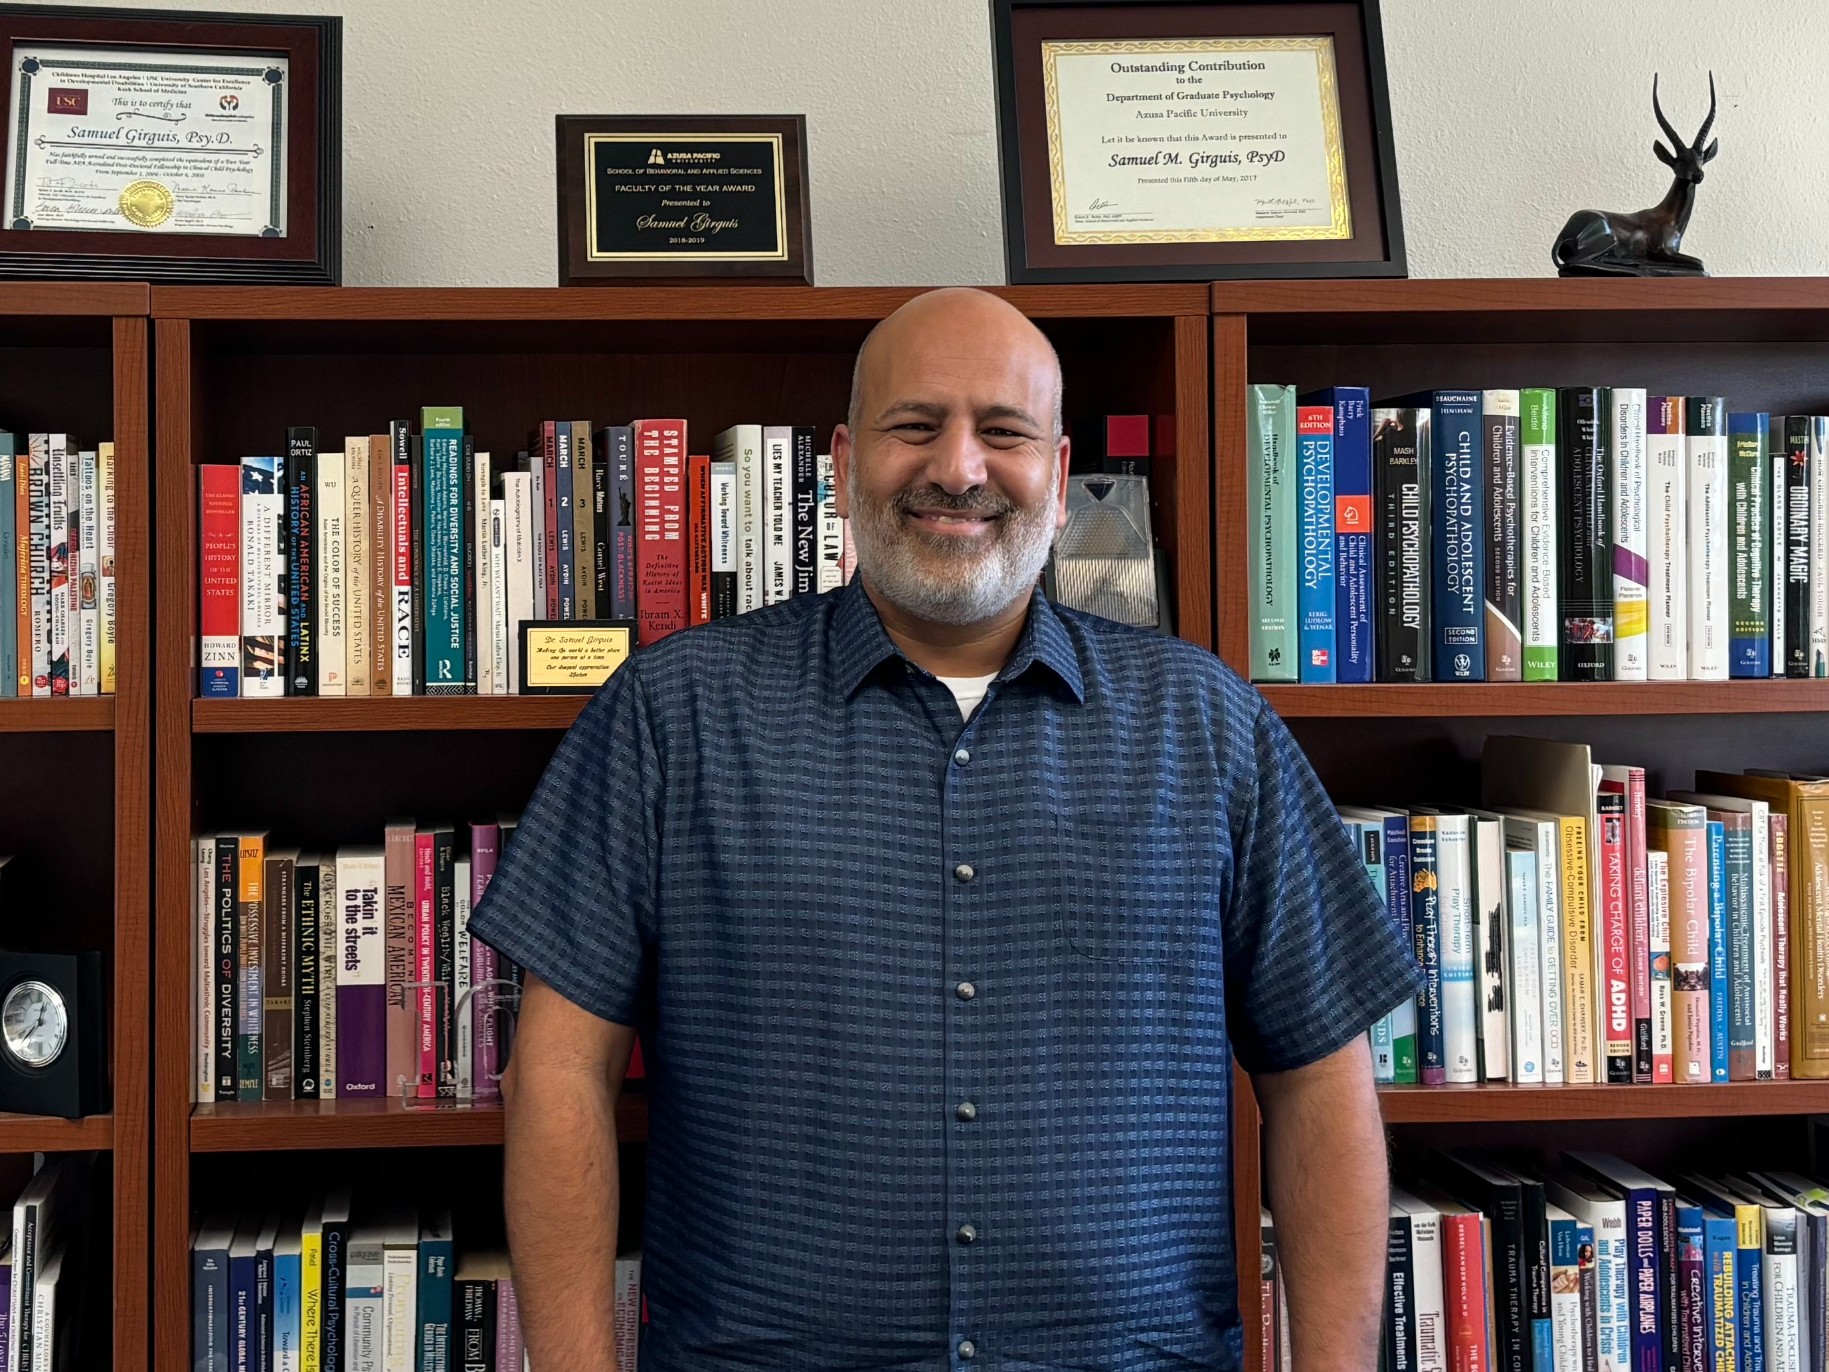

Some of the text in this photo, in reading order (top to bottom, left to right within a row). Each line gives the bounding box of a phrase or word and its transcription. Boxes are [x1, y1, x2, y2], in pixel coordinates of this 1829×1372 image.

[1111, 60, 1266, 74] Outstanding Contribution
[112, 98, 128, 106] This
[150, 100, 174, 110] certify
[176, 101, 192, 109] that
[1106, 90, 1275, 103] Department of Graduate Psychology
[1136, 108, 1248, 118] Azusa Pacific University
[67, 126, 232, 147] Samuel Girguis, Psy.D.
[1108, 150, 1285, 168] Samuel M. Girguis, PsyD
[1201, 133, 1228, 141] Award
[1239, 133, 1277, 142] presented
[636, 212, 738, 234] Samuel Girguis
[398, 428, 407, 459] Sowell
[449, 440, 457, 485] READINGS
[559, 435, 568, 468] MARCH
[300, 471, 306, 480] AN
[449, 488, 457, 504] FOR
[644, 430, 660, 540] THE BEGINNING
[773, 444, 783, 546] LIES MY TEACHER TOLD ME
[1492, 426, 1502, 542] Children and Adolescents
[85, 457, 94, 549] Tattoos on the Heart
[291, 486, 299, 535] HISTORY
[300, 484, 310, 536] AFRICAN
[398, 472, 410, 580] Intellectuals and
[562, 497, 568, 506] 2
[579, 499, 585, 508] 3
[1303, 442, 1316, 589] PSYCHOPATHOLOGY
[1316, 441, 1331, 580] DEVELOPMENTAL
[1446, 454, 1459, 594] PSYCHOPATHOLOGY
[1459, 431, 1474, 614] CHILD AND ADOLESCENT
[1506, 426, 1516, 596] Evidence-Based Psychotherapies for
[30, 468, 45, 596] BROWN CHURCH
[291, 537, 296, 546] OF
[450, 506, 459, 554] DIVERSITY
[795, 490, 814, 592] The New Jim
[1790, 486, 1808, 584] ORDINARY MAGIC
[300, 540, 310, 600] AMERICAN
[1402, 483, 1420, 629] CHILD PSYCHOPATHOLOGY
[291, 562, 299, 604] UNITED
[332, 577, 339, 589] OF
[450, 577, 459, 610] SOCIAL
[291, 609, 299, 647] STATES
[300, 622, 310, 662] LATINX
[398, 589, 410, 658] RACE
[451, 612, 459, 648] JUSTICE
[205, 652, 236, 661] ZINN
[1566, 826, 1577, 969] Obsessive-Compulsive Disorder
[1683, 838, 1698, 954] The Bipolar Child
[345, 888, 361, 971] to the streets
[1609, 852, 1626, 1031] TAKING CHARGE OF ADHD
[221, 854, 232, 1058] THE POLITICS OF DIVERSITY
[346, 1082, 375, 1091] Oxford
[1637, 1201, 1653, 1257] PAPER DOLLS
[1393, 1272, 1407, 1370] Effective Treatments
[1613, 1239, 1628, 1364] Play Therapy with Children
